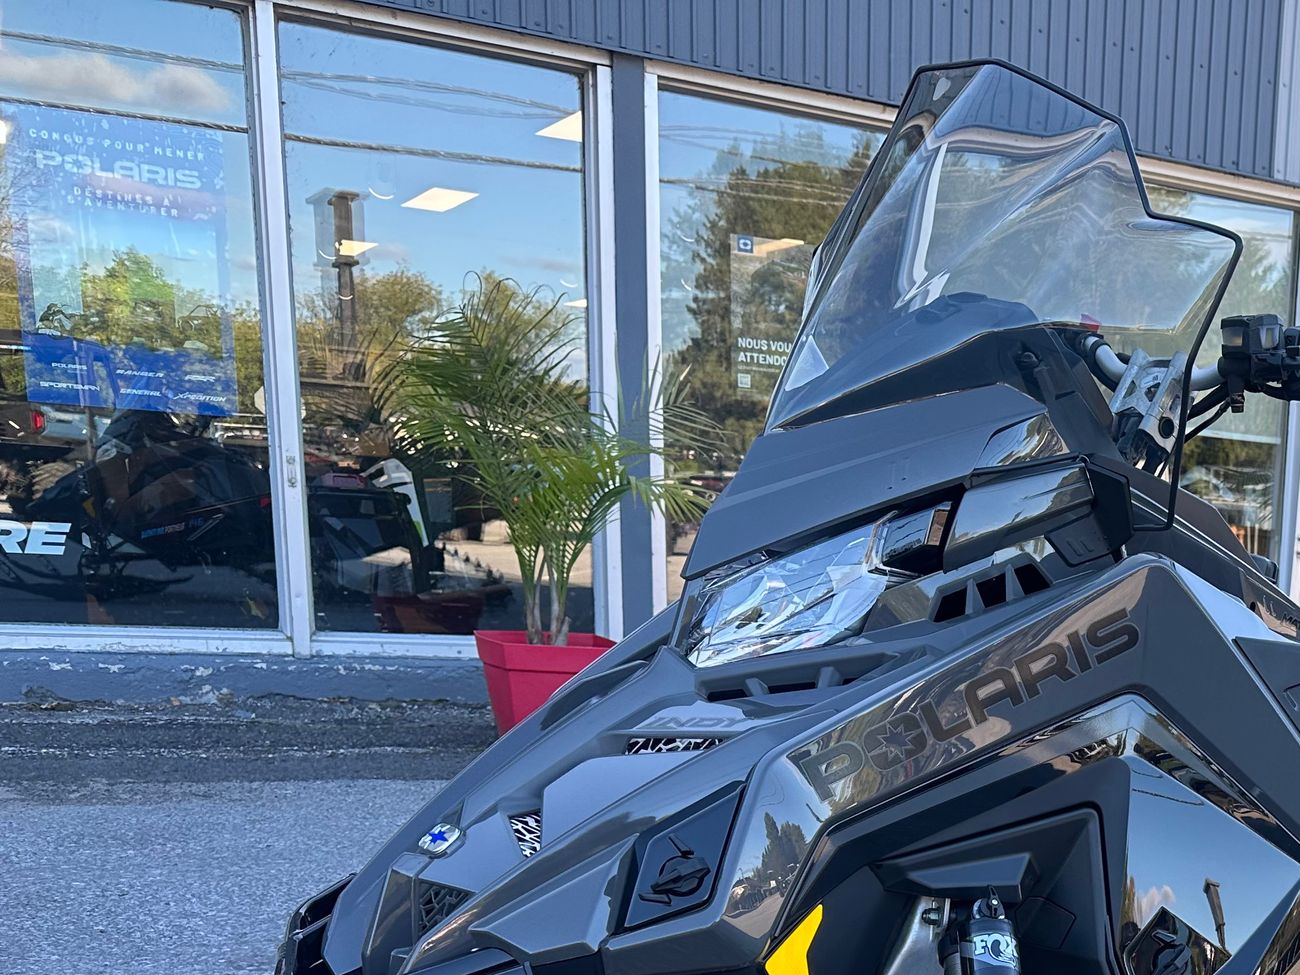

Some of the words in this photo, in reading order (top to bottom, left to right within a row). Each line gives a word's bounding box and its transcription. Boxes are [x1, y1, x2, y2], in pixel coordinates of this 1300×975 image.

[35, 149, 202, 189] POLARIS
[738, 337, 768, 350] NOUS
[770, 341, 791, 353] VOU
[51, 362, 87, 370] POLARIS
[116, 369, 164, 378] RANGER
[39, 381, 100, 392] SPORTSMAN
[120, 388, 161, 397] GENERAL
[173, 391, 227, 402] XPEDITION
[800, 607, 1142, 802] POLARIS
[973, 933, 1019, 967] FOX
